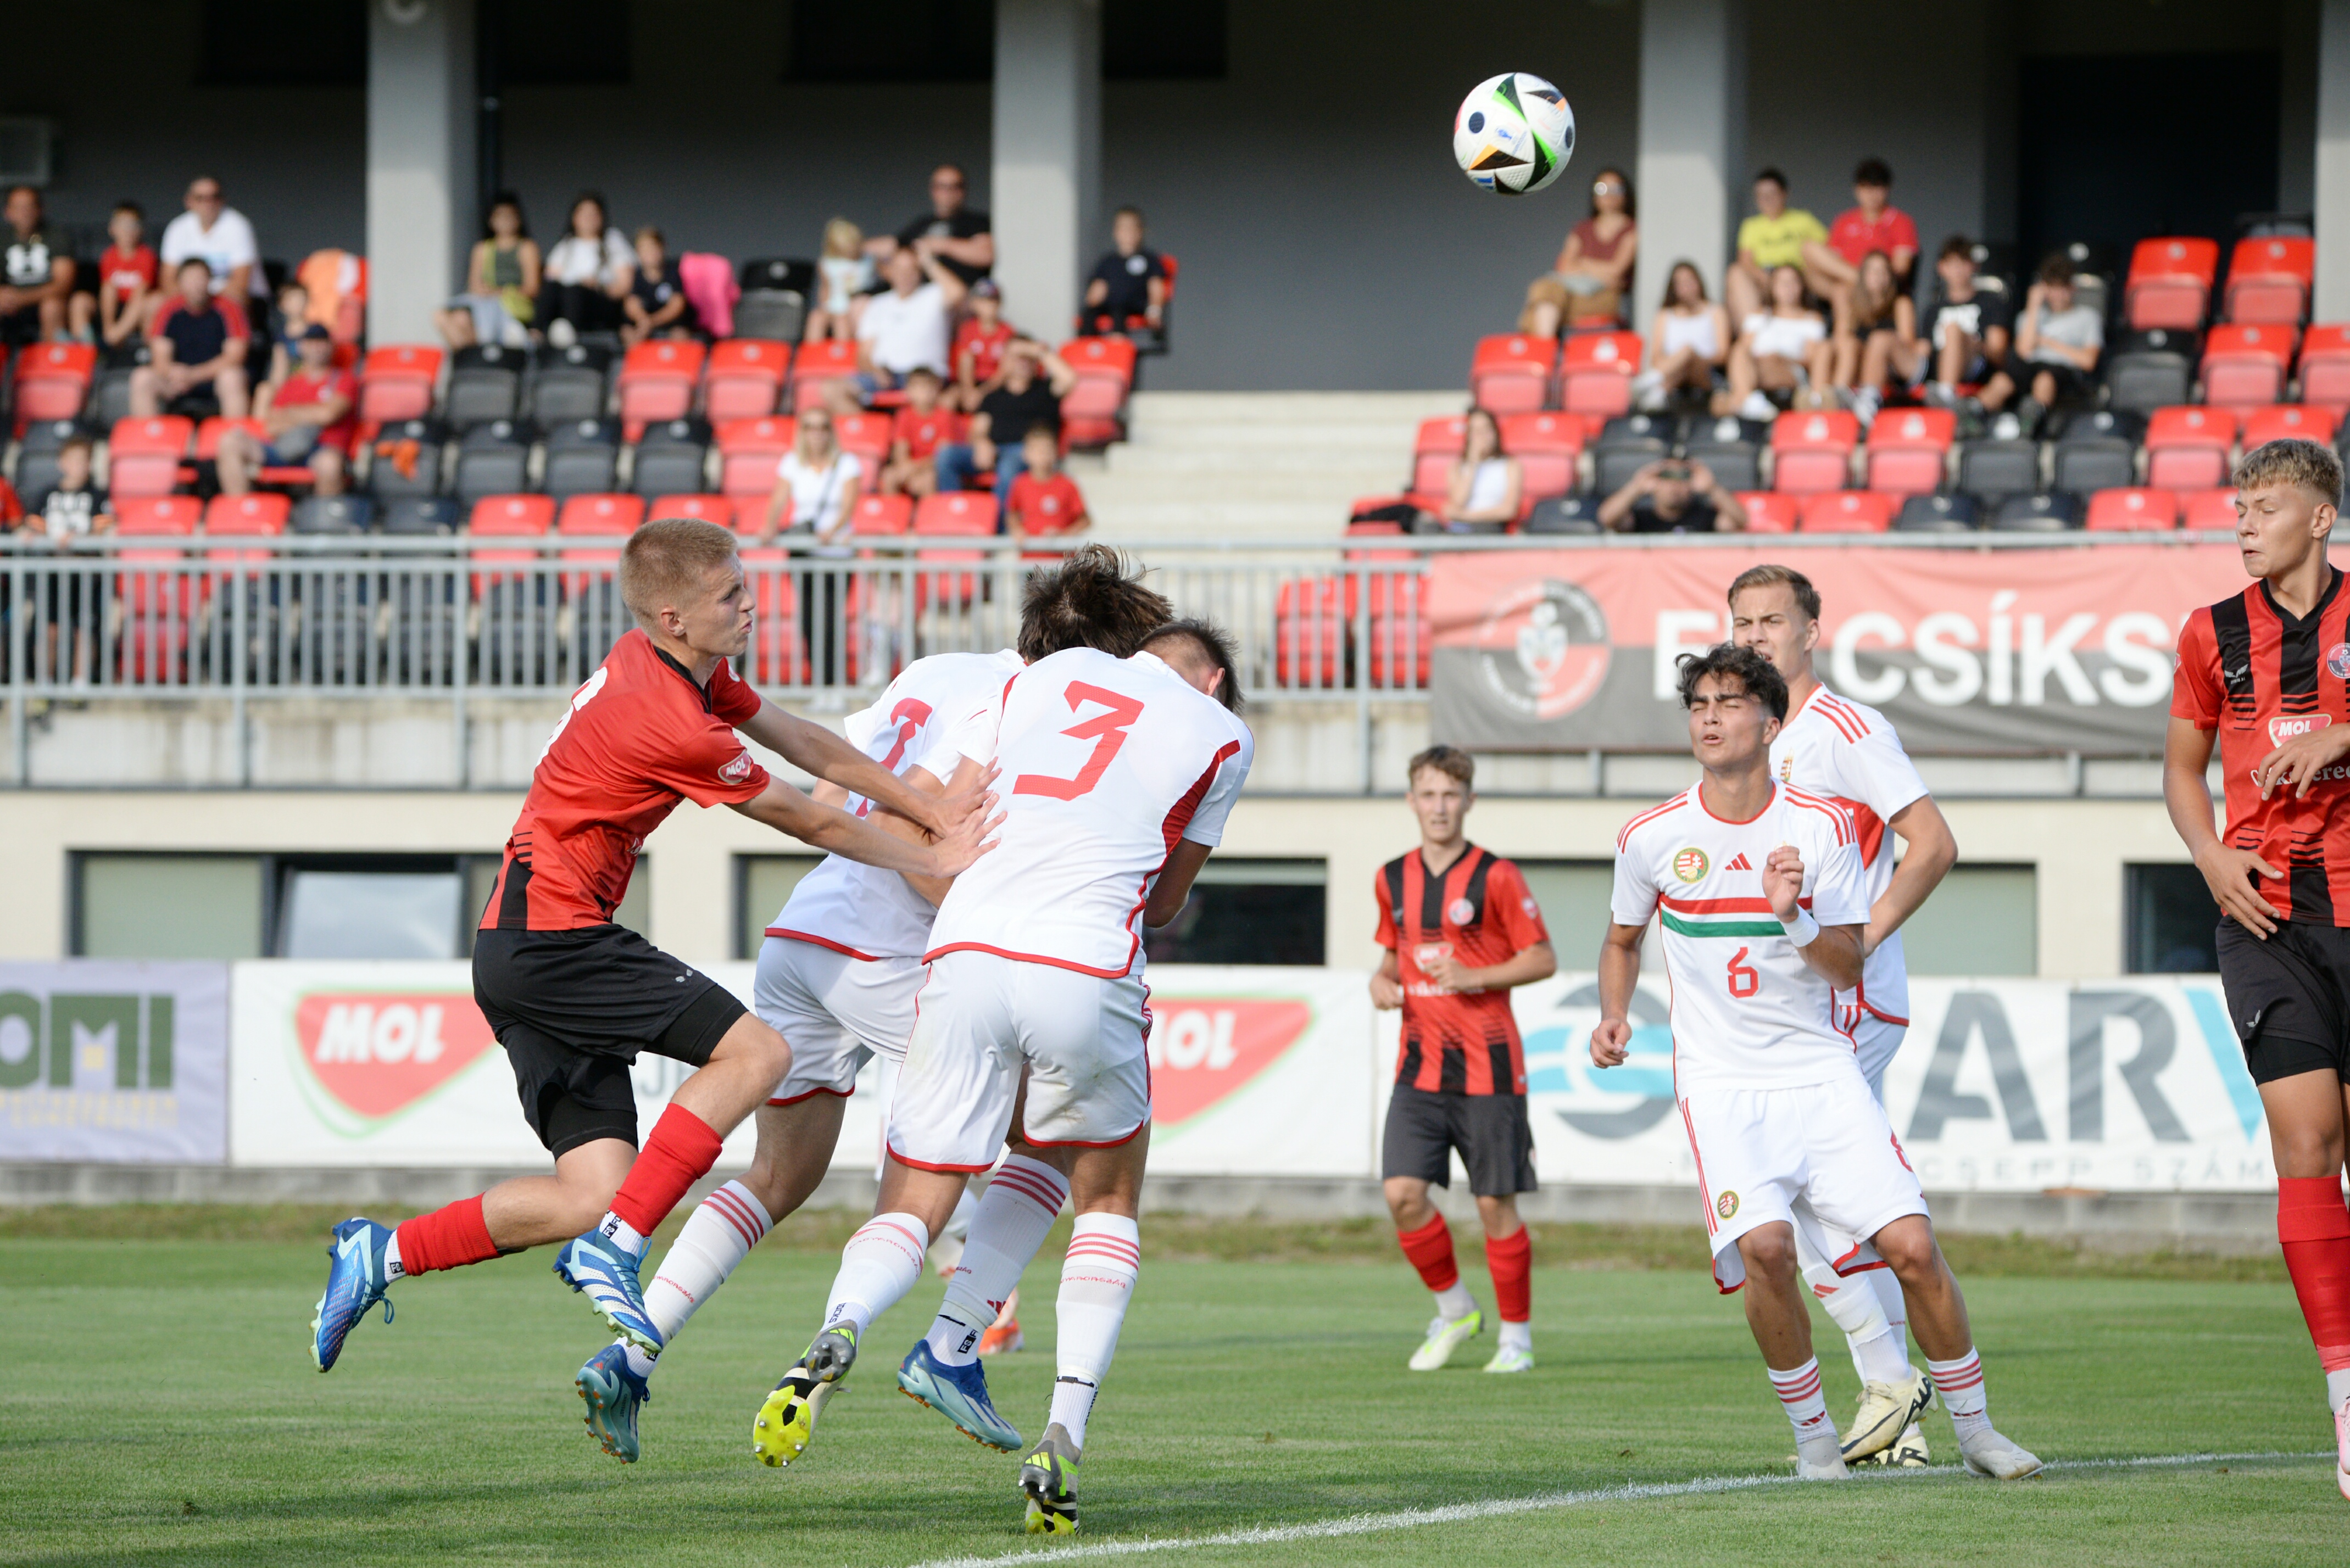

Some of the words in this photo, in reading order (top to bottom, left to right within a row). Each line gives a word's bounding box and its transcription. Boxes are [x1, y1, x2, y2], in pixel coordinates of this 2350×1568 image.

[1831, 590, 2190, 707] CSÍKS
[1012, 680, 1144, 801] 3
[2278, 721, 2311, 736] MOL
[726, 758, 746, 777] MOL
[1728, 946, 1758, 998] 6
[317, 1003, 445, 1063] MOL
[1920, 1156, 2093, 1181] CSEPP
